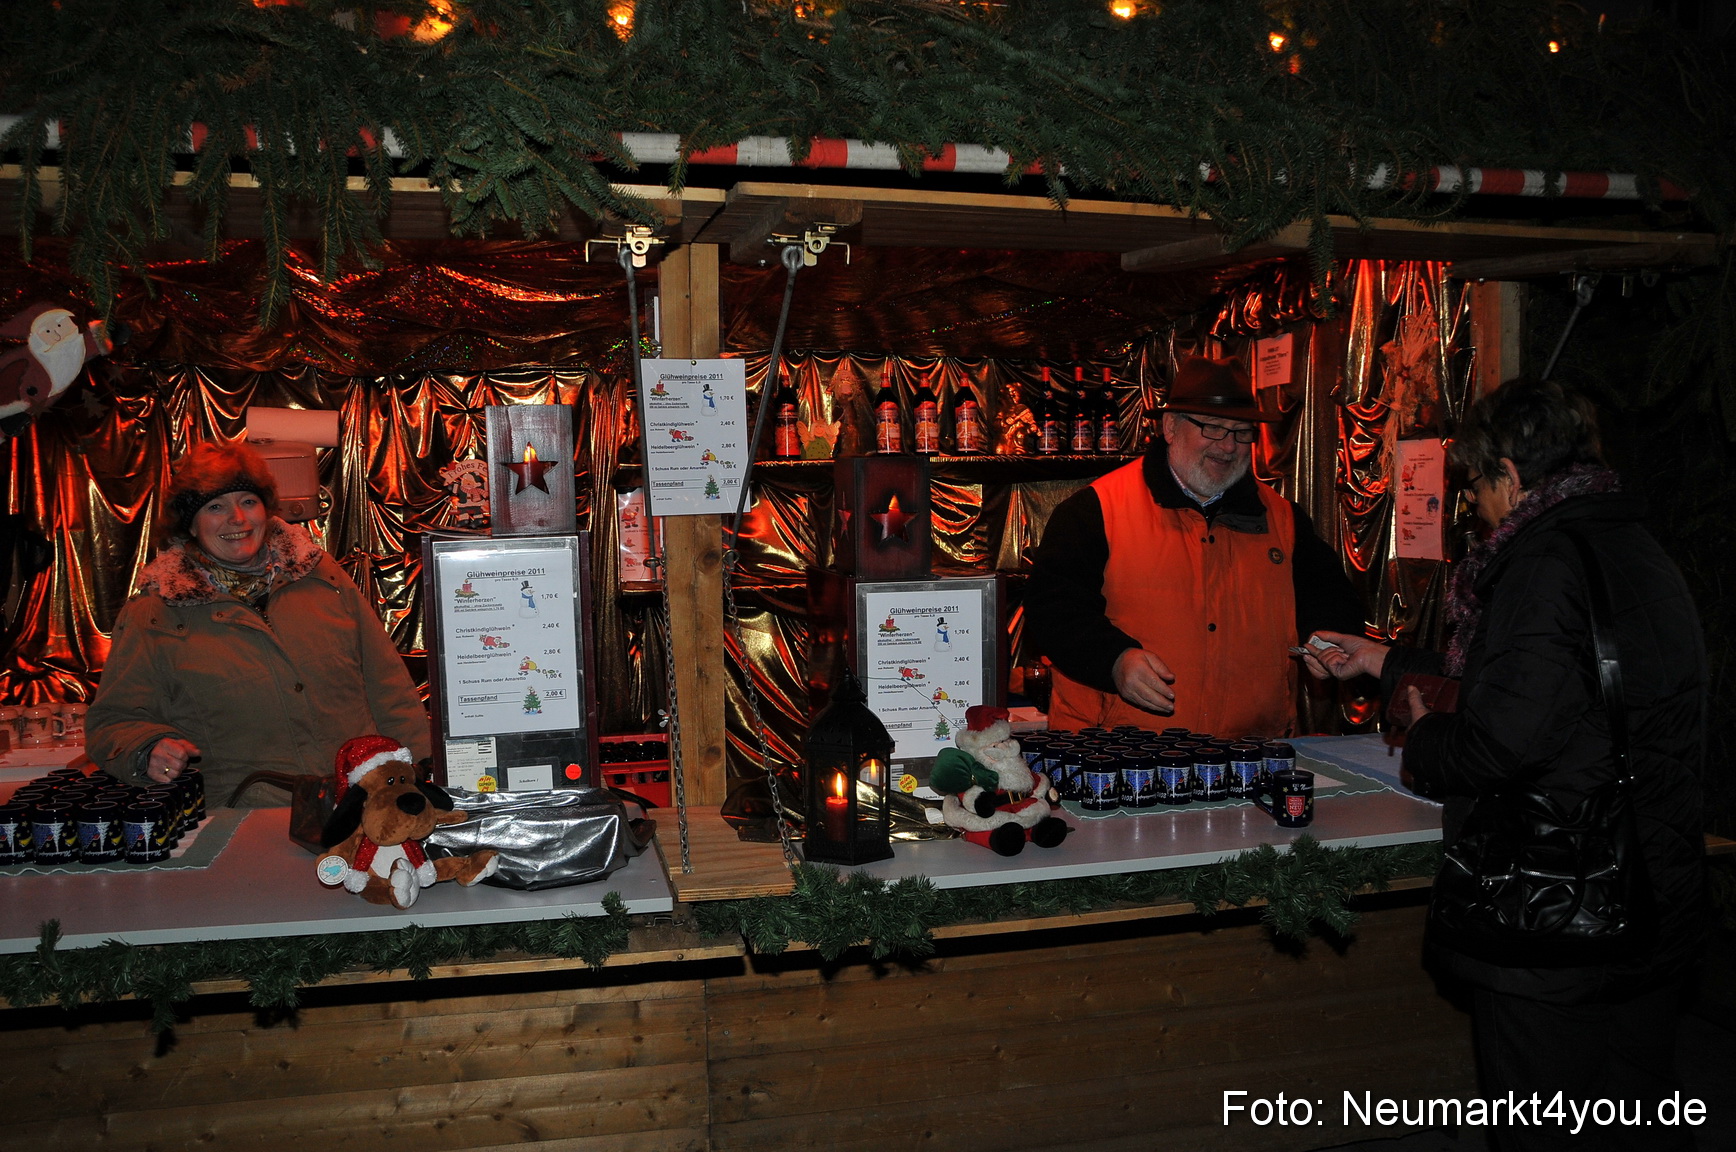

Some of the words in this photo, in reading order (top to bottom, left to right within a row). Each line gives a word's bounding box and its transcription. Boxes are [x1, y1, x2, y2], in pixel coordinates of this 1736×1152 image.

[660, 374, 707, 382] Glühweinpreise
[448, 463, 475, 478] Frohes
[466, 570, 526, 578] Glühweinpreise
